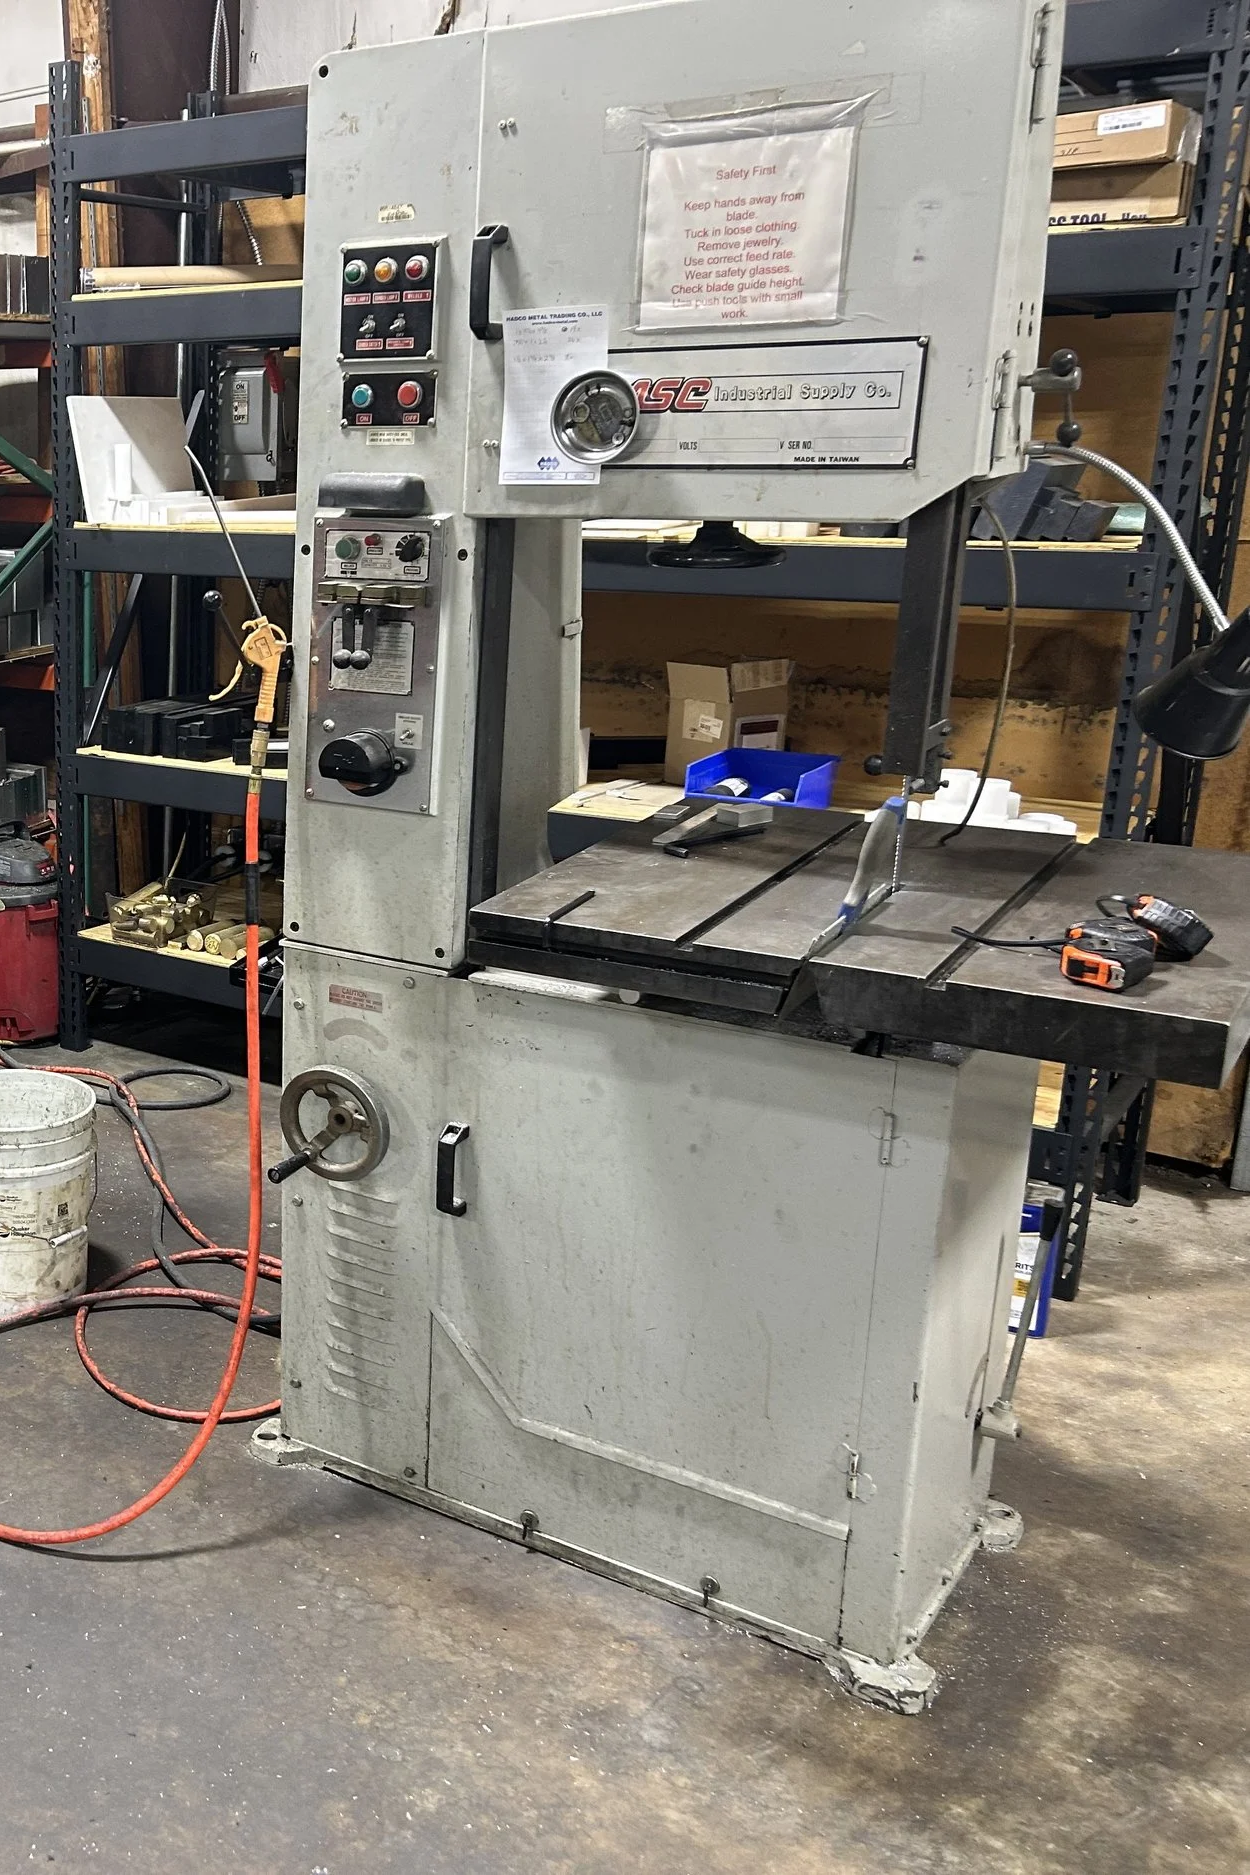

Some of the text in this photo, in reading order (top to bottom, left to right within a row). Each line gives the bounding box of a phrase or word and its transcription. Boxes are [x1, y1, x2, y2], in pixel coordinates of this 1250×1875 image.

[716, 165, 776, 181] Safety First
[684, 191, 805, 213] Keep hands away from
[726, 211, 758, 221] blade.
[685, 227, 709, 238] Tuck
[712, 226, 720, 236] in
[724, 224, 753, 236] loose
[697, 236, 784, 251] Remove jewelry.
[684, 250, 795, 266] Use correct feed rate.
[685, 264, 792, 280] Wear safety glasses.
[671, 276, 805, 295] Check blade guide height.
[695, 296, 720, 309] push
[722, 294, 748, 305] tools
[750, 292, 773, 303] with
[774, 290, 803, 301] small
[721, 309, 748, 319] work.
[713, 383, 792, 402] Industrial
[800, 382, 856, 401] Supply
[863, 381, 892, 398] Co.
[679, 440, 698, 451] VOLTS
[787, 440, 800, 450] SER
[341, 987, 367, 998] CAUTION
